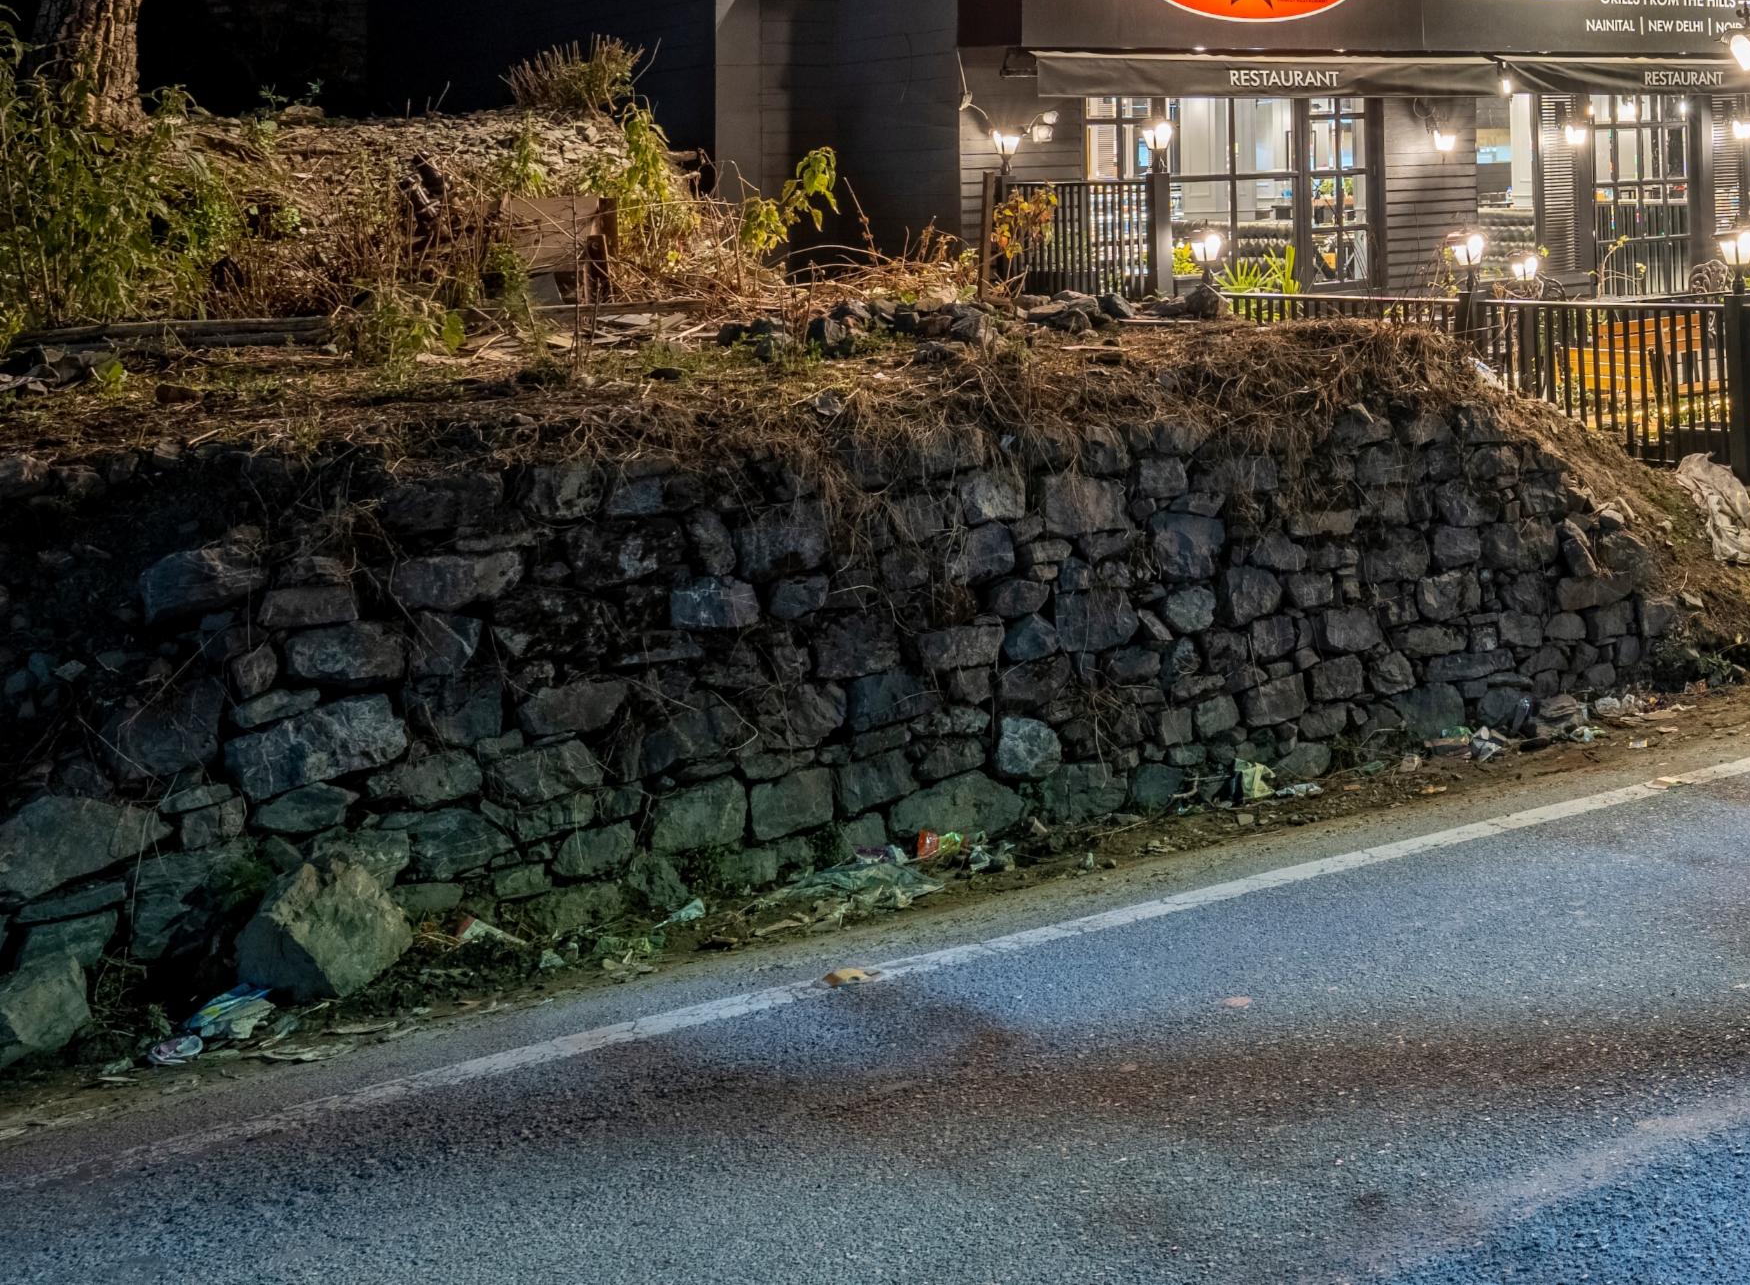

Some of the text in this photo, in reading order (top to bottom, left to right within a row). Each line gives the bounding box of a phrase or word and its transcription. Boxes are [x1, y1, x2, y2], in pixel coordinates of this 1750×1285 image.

[1586, 18, 1635, 32] NAINITAL
[1648, 19, 1675, 33] NEW
[1676, 20, 1704, 33] DELHI
[1229, 69, 1339, 87] RESTAURANT
[1644, 71, 1724, 86] RESTAURANT
